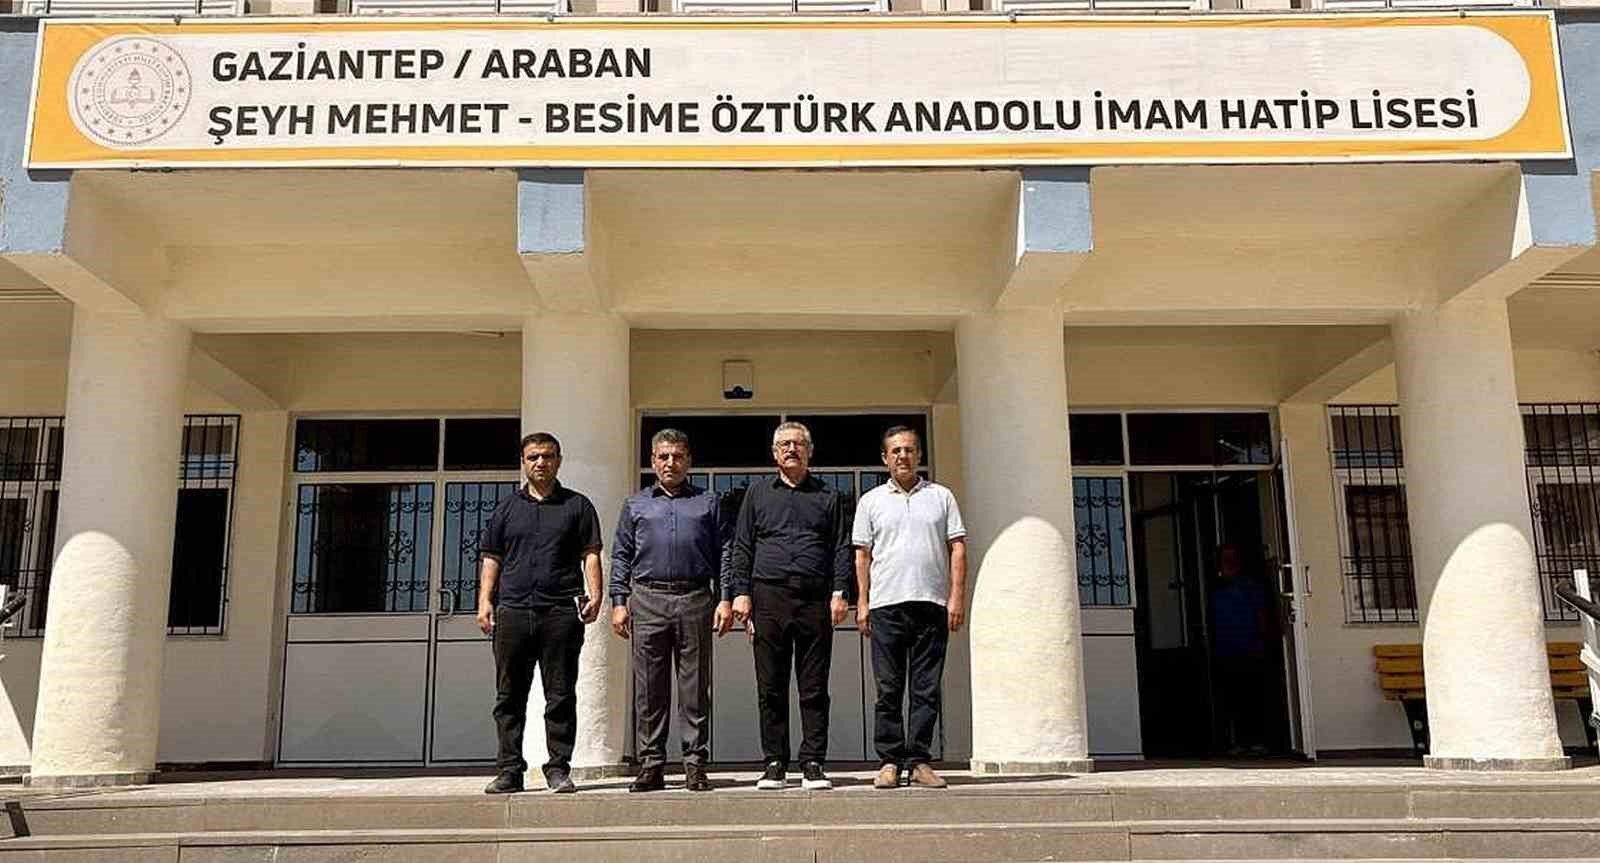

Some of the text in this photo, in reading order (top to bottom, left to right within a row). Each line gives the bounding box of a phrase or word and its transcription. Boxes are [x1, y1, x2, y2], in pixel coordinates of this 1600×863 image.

[212, 41, 651, 82] GAZİANTEP / ARABAN
[207, 104, 315, 146] ŞEYH
[327, 103, 509, 135] MEHMET
[545, 93, 700, 133] BESİME
[711, 94, 877, 133] ÖZTÜRK
[884, 100, 1082, 132] ANADOLU
[1094, 90, 1208, 130] İMAM
[1220, 89, 1340, 130] HATİP
[1349, 88, 1478, 129] LİSESİ
